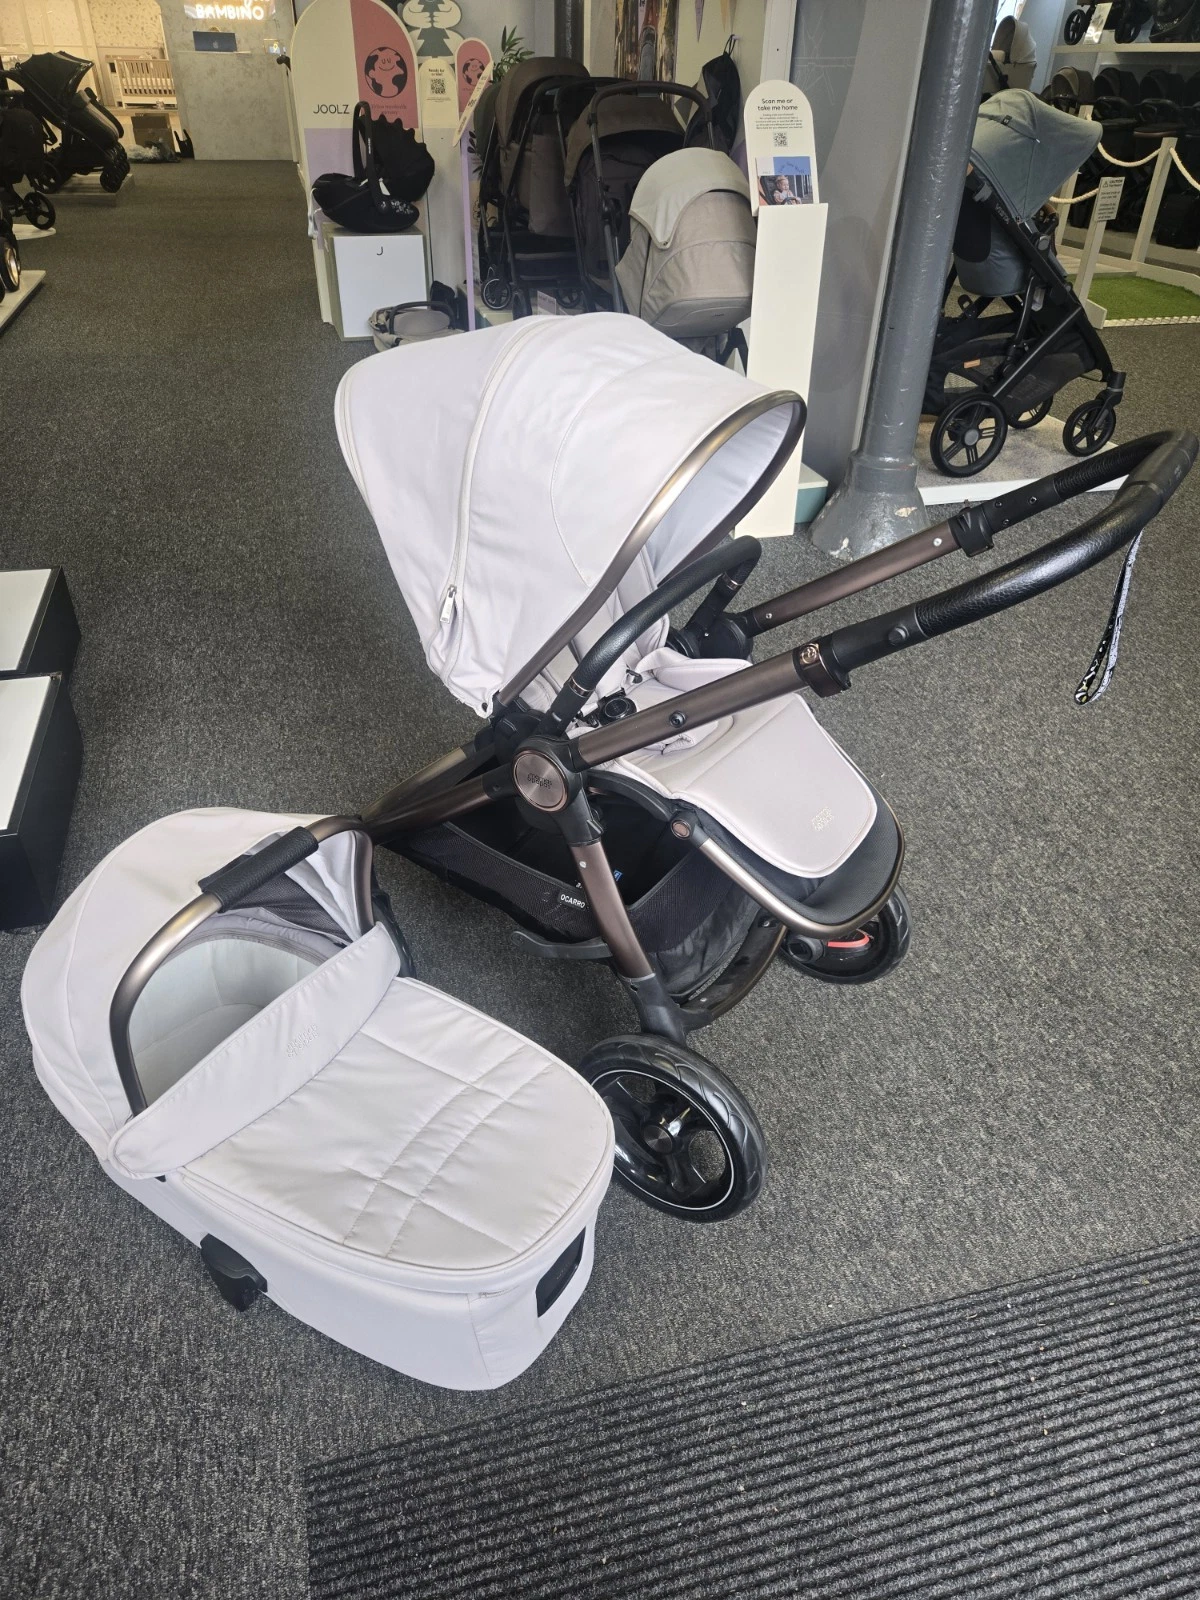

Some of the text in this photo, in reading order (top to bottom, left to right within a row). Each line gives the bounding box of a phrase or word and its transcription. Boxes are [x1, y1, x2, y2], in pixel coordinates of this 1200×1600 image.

[195, 4, 264, 20] BAMBINO
[313, 104, 350, 115] JOOLZ
[560, 893, 586, 909] OCARRO
